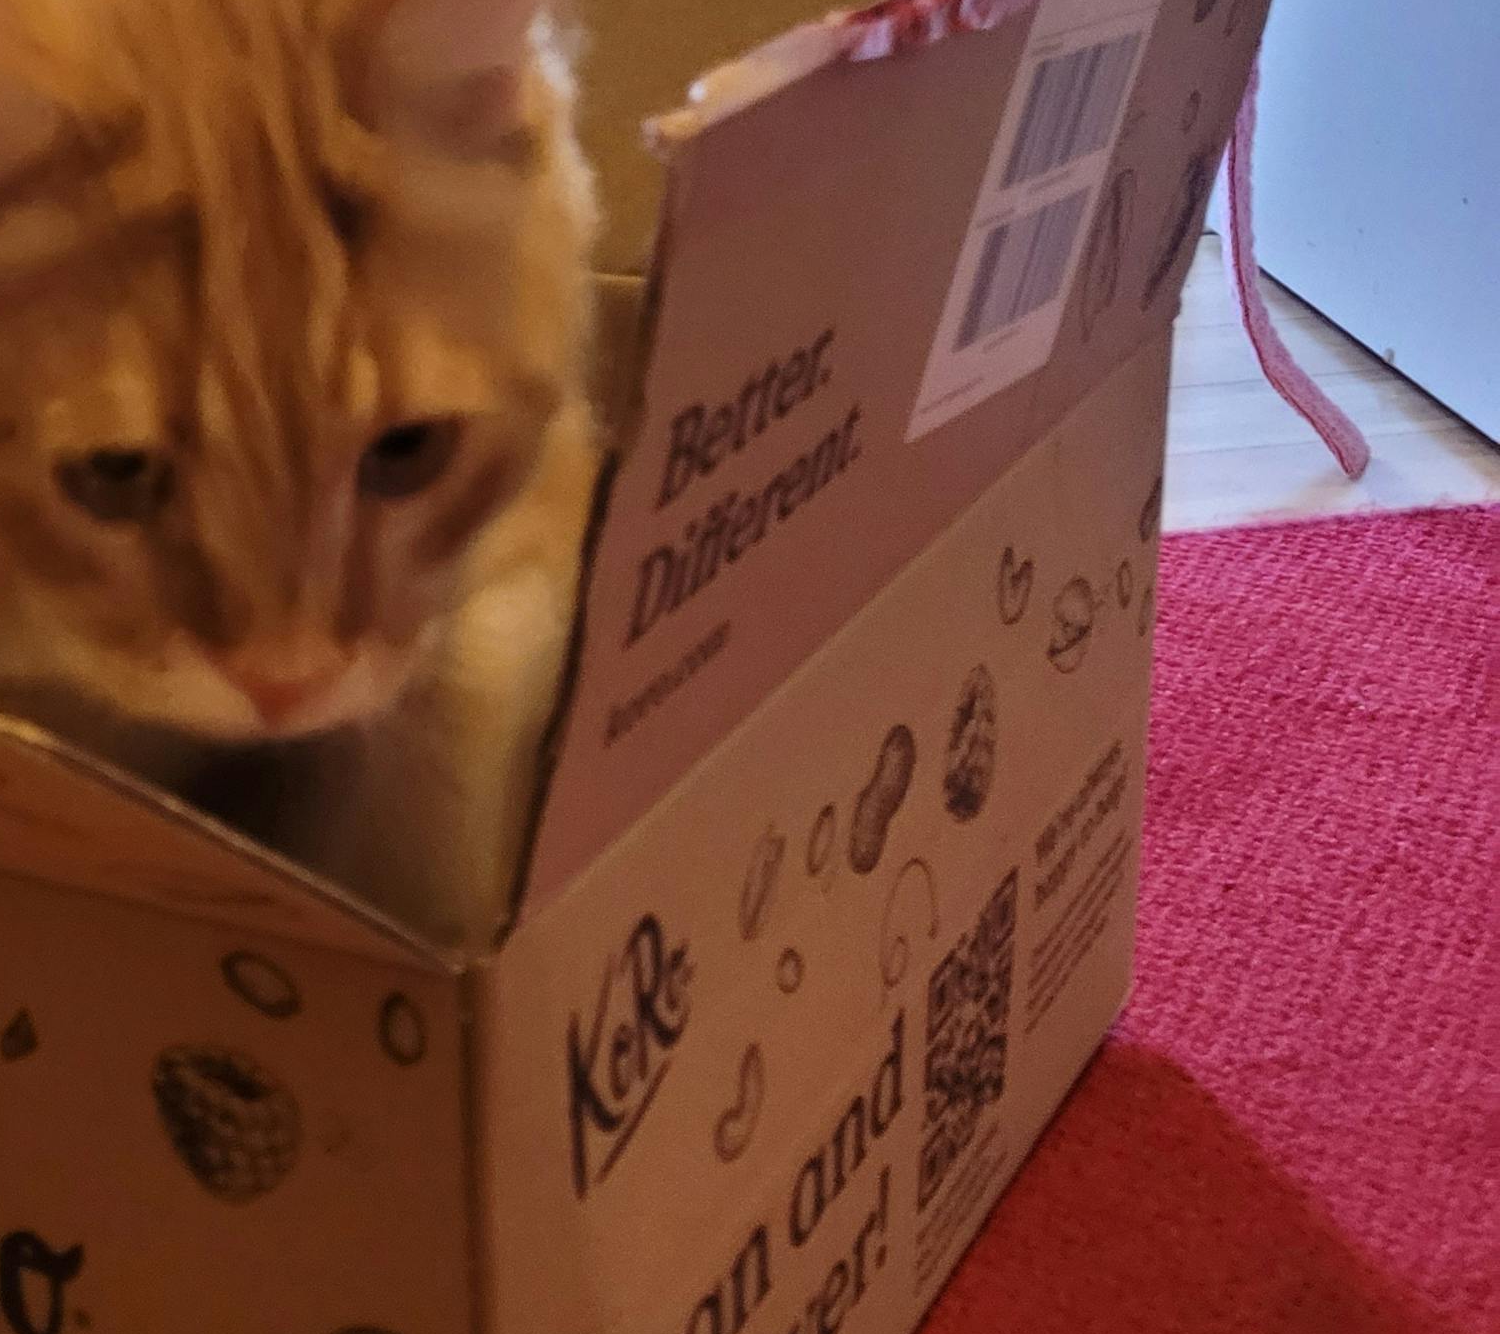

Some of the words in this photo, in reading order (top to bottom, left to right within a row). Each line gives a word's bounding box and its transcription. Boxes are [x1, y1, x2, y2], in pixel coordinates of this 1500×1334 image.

[622, 402, 863, 651] Different.
[654, 326, 837, 512] Better.
[788, 1005, 907, 1249] and
